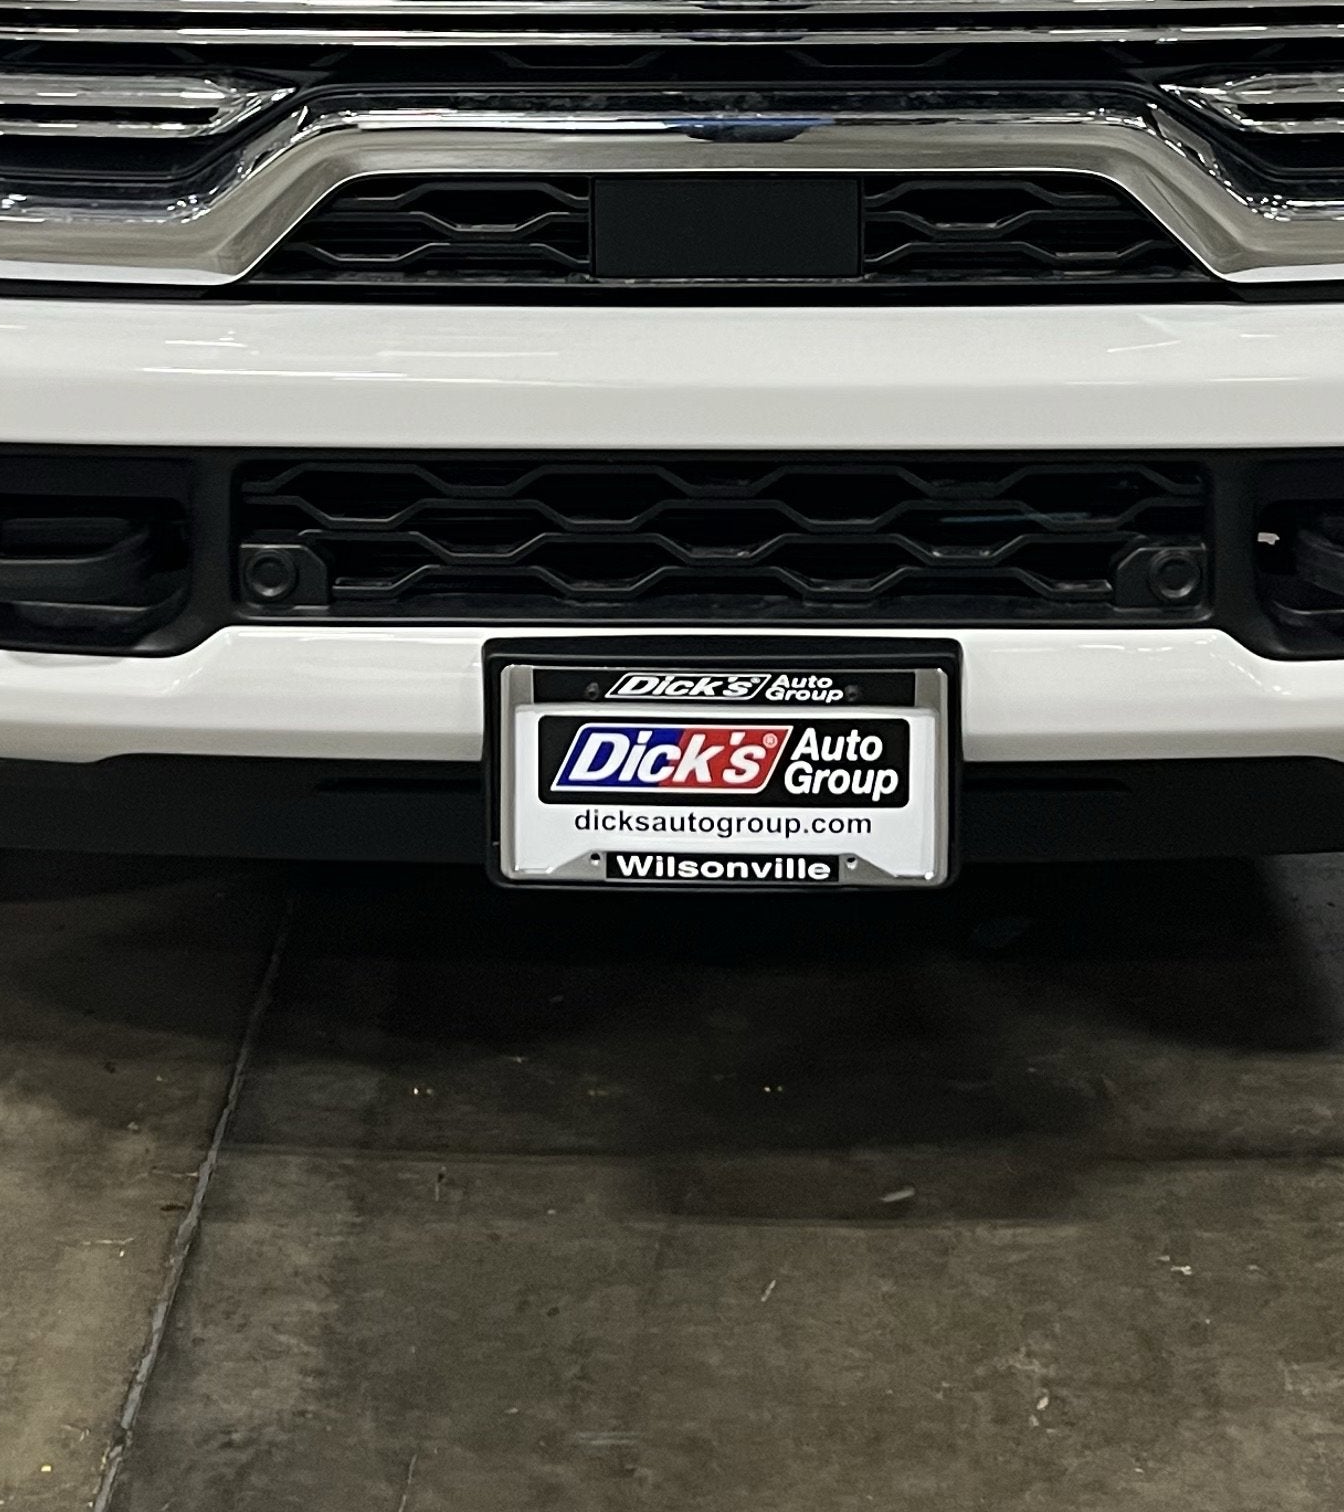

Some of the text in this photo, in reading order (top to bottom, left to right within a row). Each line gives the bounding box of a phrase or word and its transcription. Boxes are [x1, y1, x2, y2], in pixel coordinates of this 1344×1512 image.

[765, 687, 844, 703] Group
[771, 674, 834, 689] Auto
[790, 727, 883, 762] Auto
[784, 760, 899, 802] Group
[574, 809, 872, 839] dicksautogroup.com
[615, 854, 832, 881] Wilsonville
